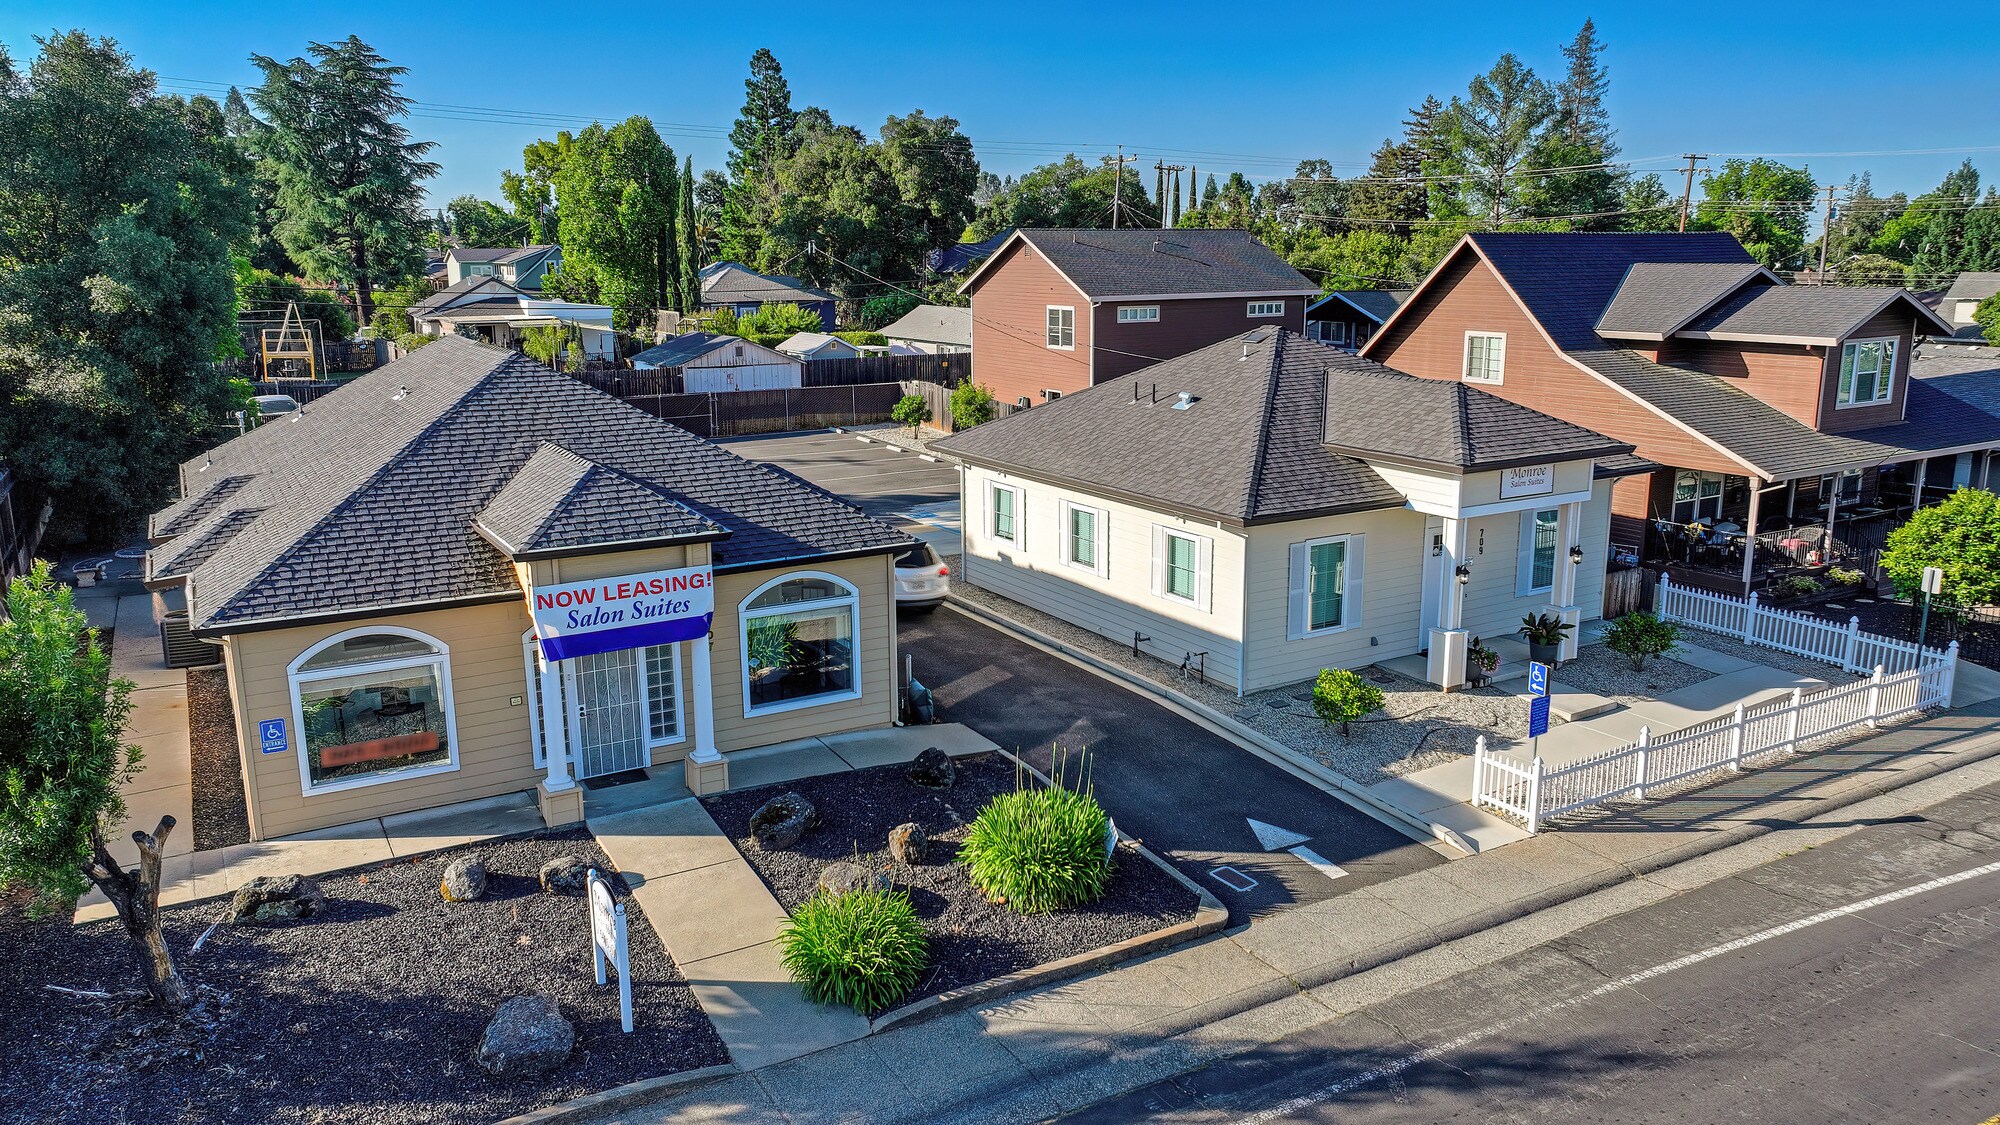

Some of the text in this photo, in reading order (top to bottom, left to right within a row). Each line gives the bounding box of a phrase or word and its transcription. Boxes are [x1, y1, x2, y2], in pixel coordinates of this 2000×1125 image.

[1511, 467, 1547, 479] Monroe
[537, 572, 712, 610] NOW LEASING!
[567, 598, 690, 629] Salon Suites
